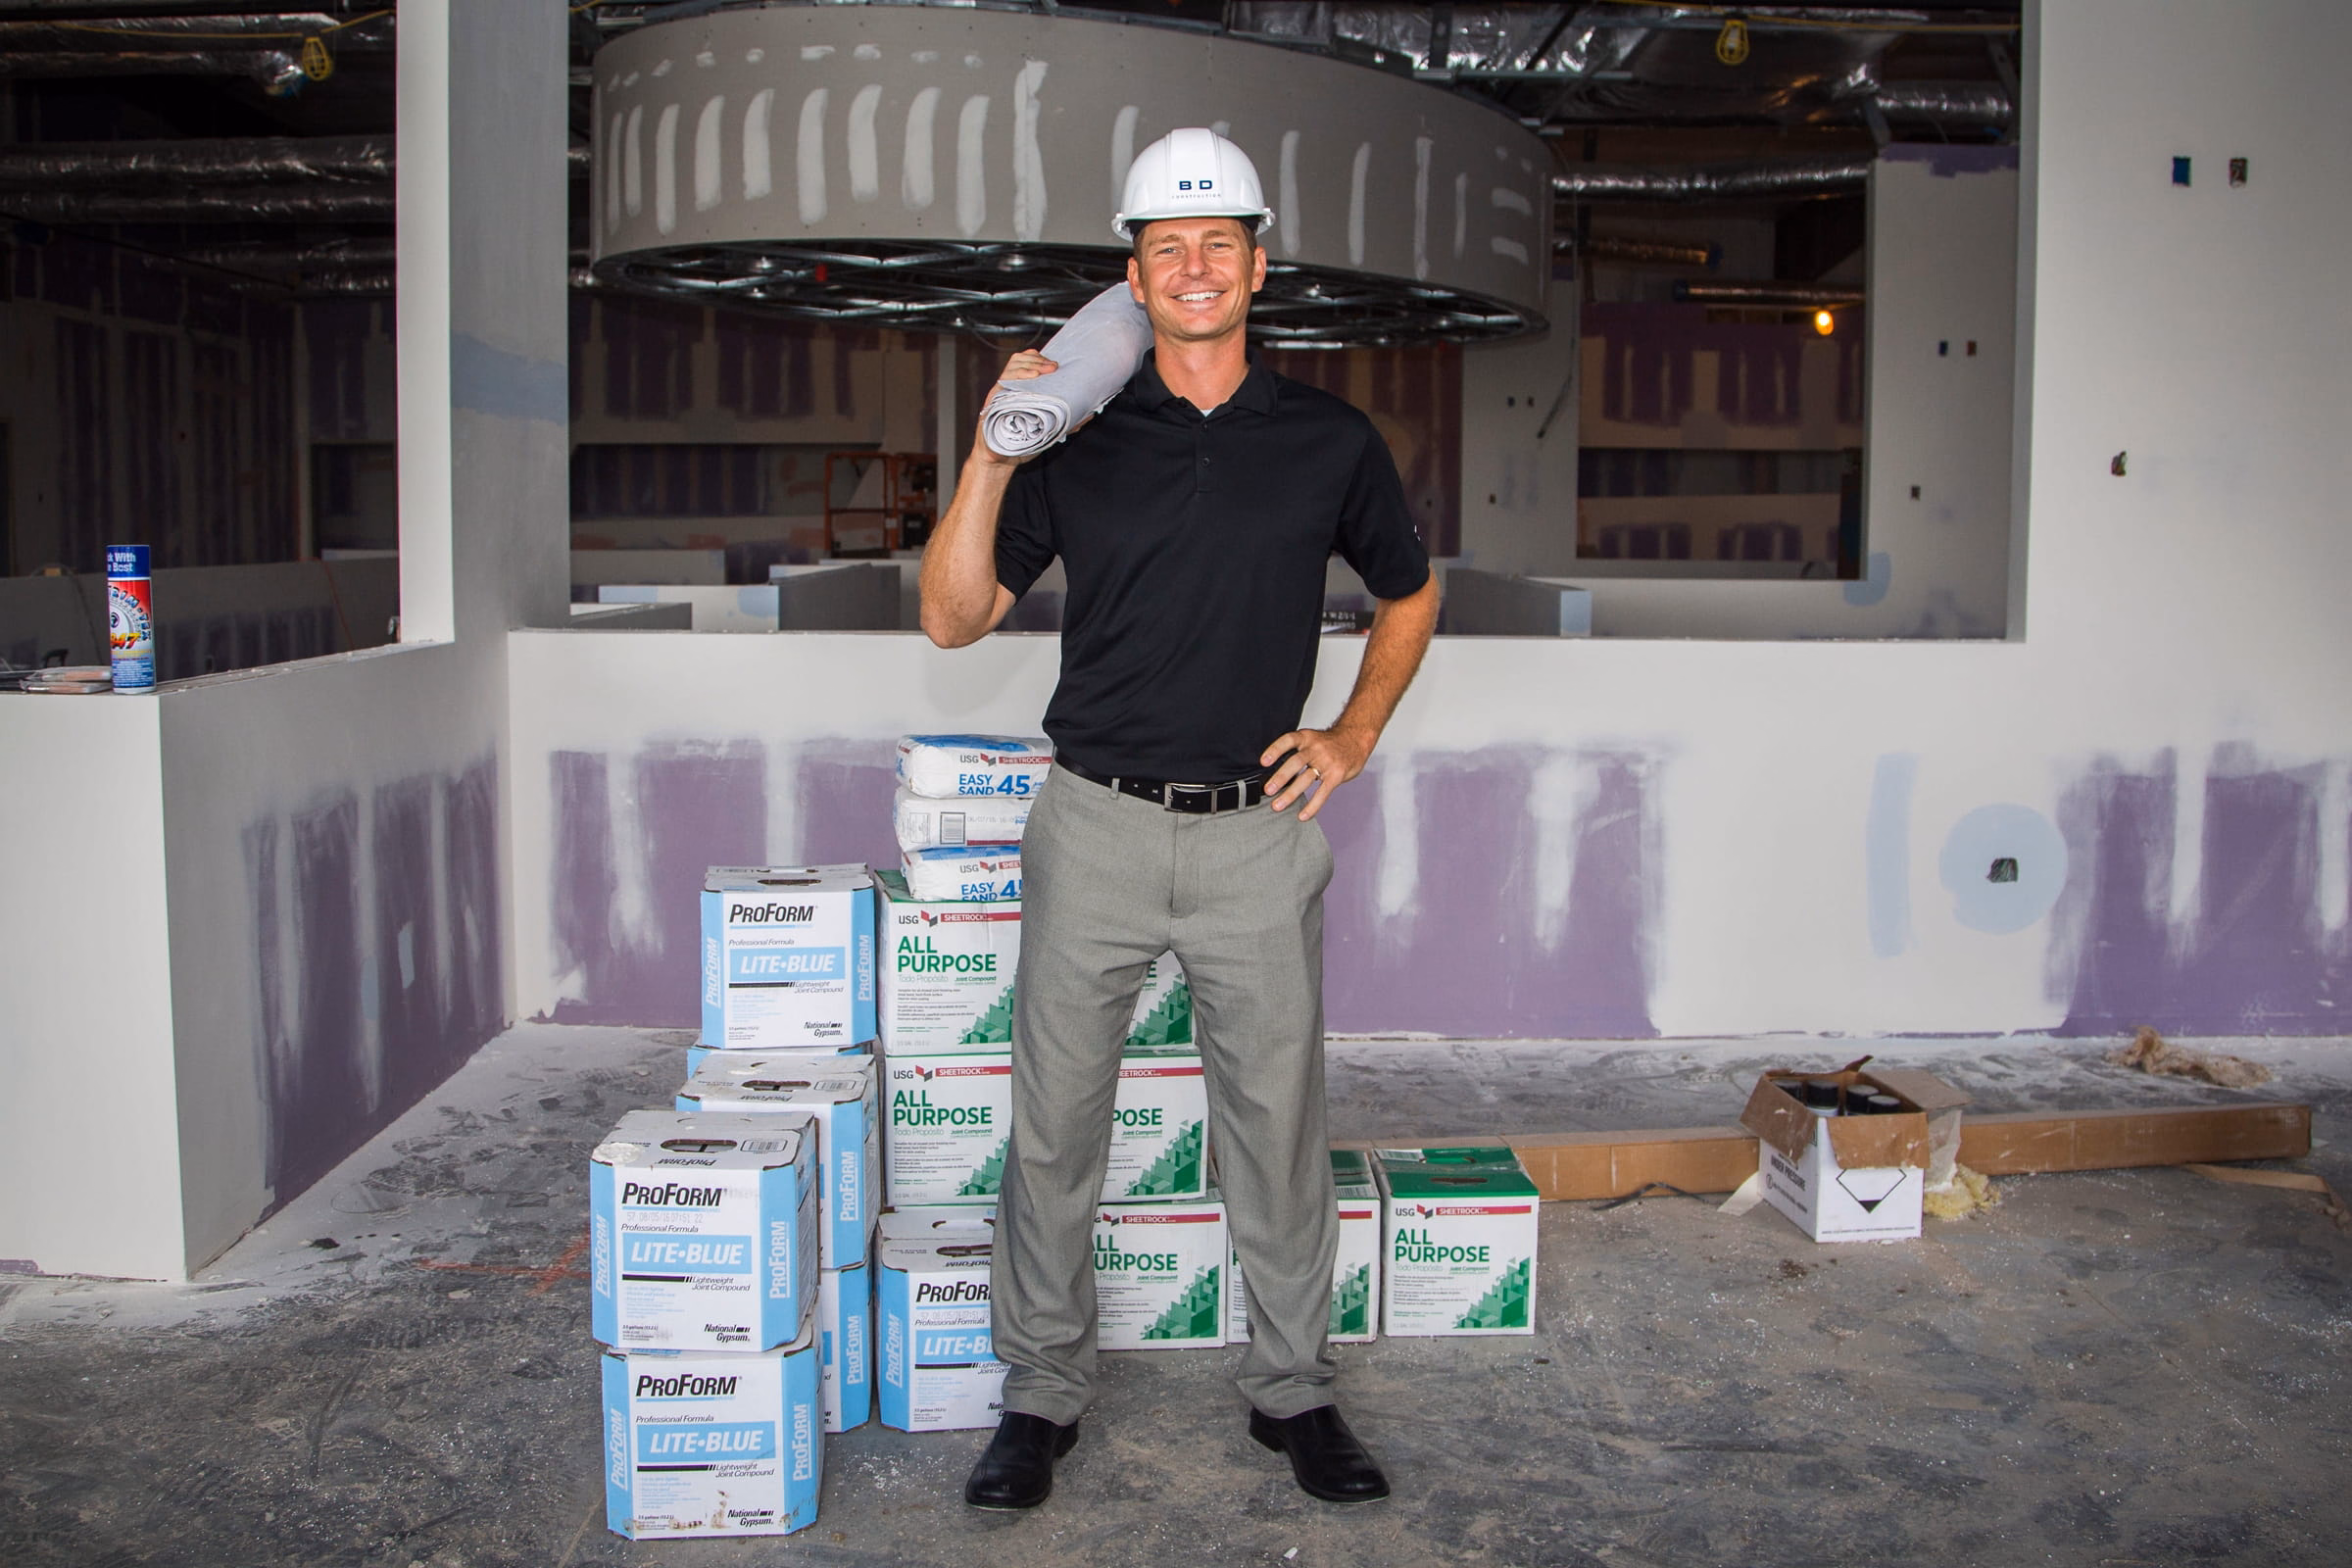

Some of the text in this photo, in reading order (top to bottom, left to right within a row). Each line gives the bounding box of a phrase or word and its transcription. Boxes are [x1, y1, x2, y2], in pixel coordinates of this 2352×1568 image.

[114, 552, 136, 562] With
[960, 755, 979, 763] USG
[958, 774, 993, 785] EASY
[997, 774, 1030, 795] 45
[958, 786, 994, 795] SAND
[960, 864, 979, 873] USG
[961, 879, 1022, 898] EASY 4
[898, 915, 919, 925] USG
[898, 936, 937, 954] ALL
[898, 954, 997, 973] PURPOSE
[804, 1021, 831, 1029] National
[893, 1070, 914, 1079] USG
[893, 1090, 933, 1107] ALL
[893, 1106, 993, 1126] PURPOSE
[1113, 1108, 1163, 1127] POSE
[1396, 1207, 1415, 1217] USG
[621, 1223, 668, 1232] Professional
[1395, 1228, 1433, 1245] ALL
[1092, 1234, 1120, 1251] LL
[1395, 1246, 1490, 1263] PURPOSE
[1094, 1253, 1178, 1271] URPOSE
[692, 1276, 734, 1285] Lightweight
[710, 1284, 751, 1292] Compound
[704, 1323, 736, 1333] National
[716, 1333, 748, 1343] Gypsum
[636, 1415, 683, 1423] Professional
[716, 1463, 758, 1471] Lightweight
[735, 1469, 775, 1478] Compound
[728, 1509, 760, 1519] National
[739, 1518, 771, 1527] Gypsum
